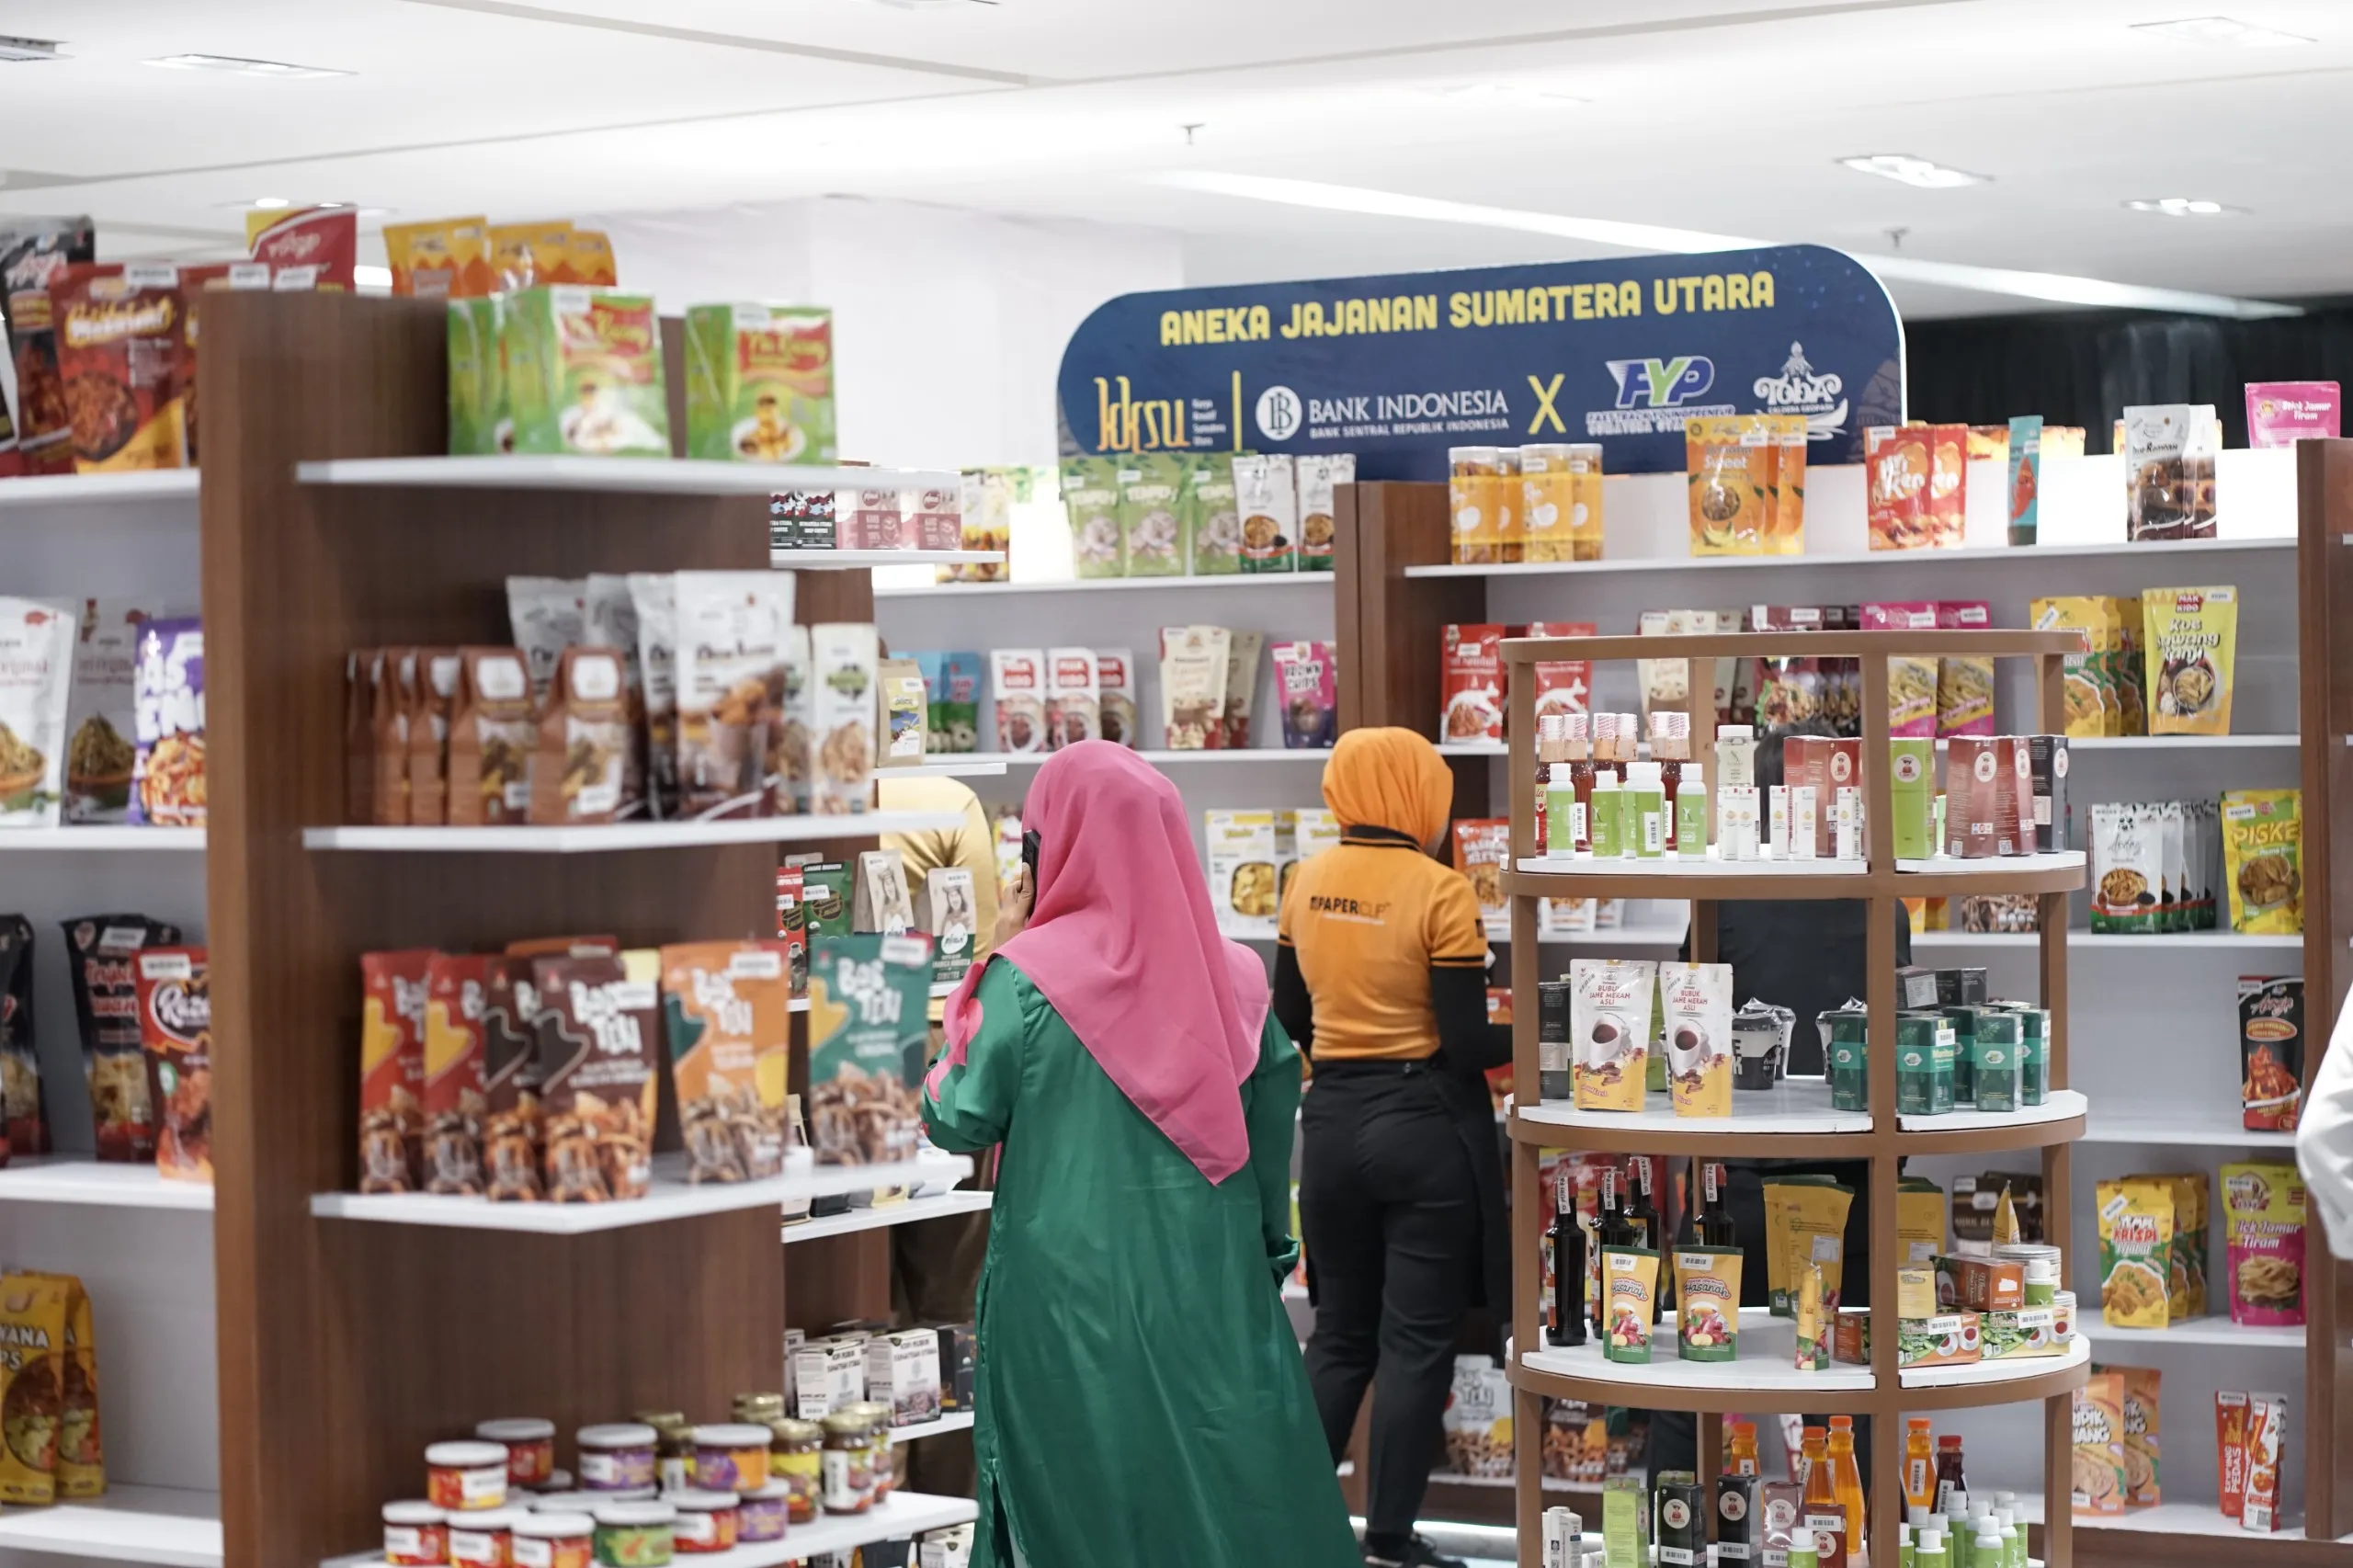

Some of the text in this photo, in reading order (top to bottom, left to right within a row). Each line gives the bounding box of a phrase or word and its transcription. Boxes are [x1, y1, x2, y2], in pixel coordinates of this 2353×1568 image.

[1160, 271, 1775, 347] ANEKA JAJANAN SUMATERA UTARA
[1606, 356, 1714, 409] FYP
[1309, 390, 1509, 424] BANK INDONESIA
[1310, 418, 1509, 439] BANK SENTRAL REPUBLIK INDONESIA
[1672, 996, 1688, 1005] JAHE
[2243, 1235, 2280, 1249] Tiram
[1684, 1280, 1731, 1301] Hasanah
[2231, 1447, 2242, 1494] PEDAS
